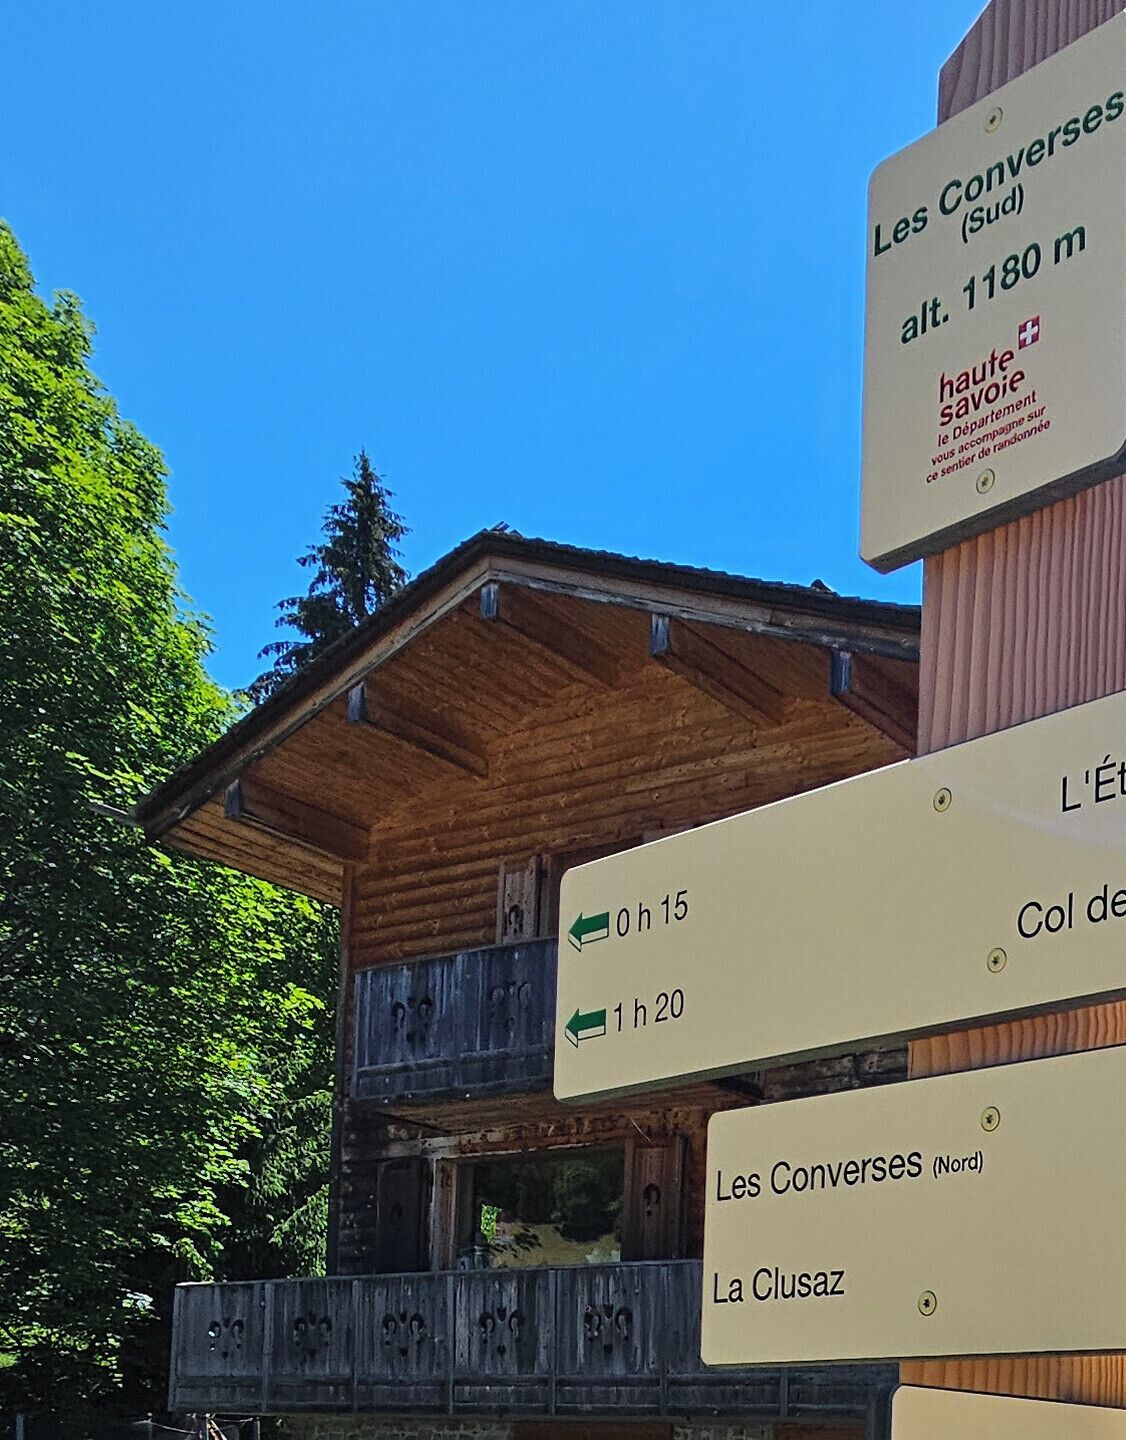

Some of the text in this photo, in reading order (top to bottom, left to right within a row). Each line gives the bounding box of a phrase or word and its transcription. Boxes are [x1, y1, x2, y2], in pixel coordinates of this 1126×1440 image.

[873, 89, 1126, 258] Les Converses
[961, 182, 1025, 244] (Sud)
[899, 224, 1087, 344] alt. 1180 m
[939, 370, 1026, 426] savoie
[940, 348, 1015, 403] haute
[931, 406, 1046, 466] vous accompagne sur
[937, 390, 1037, 448] le Département
[926, 419, 1051, 484] ce sentier de randonnée
[1017, 892, 1074, 939] Col
[716, 1151, 984, 1201] Les Converses (Nord)
[713, 1266, 845, 1304] La Clusaz
